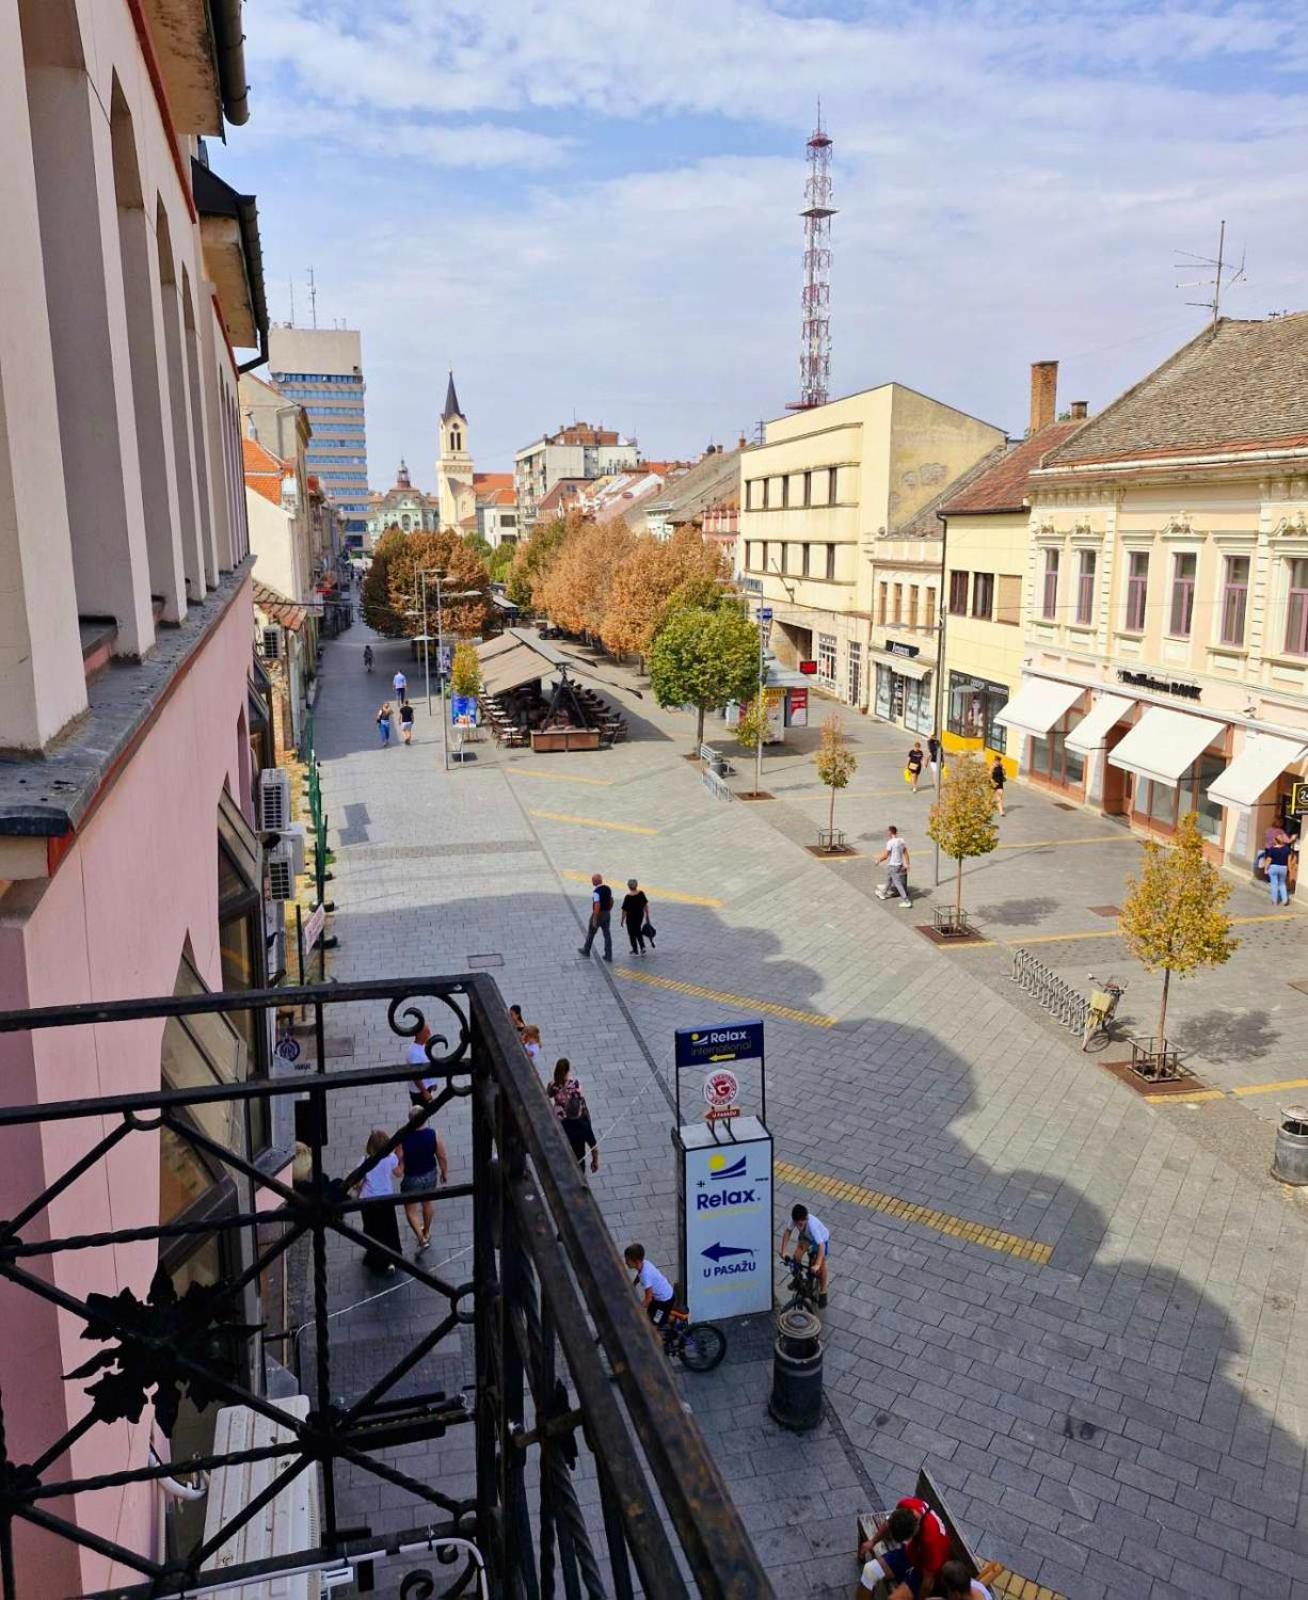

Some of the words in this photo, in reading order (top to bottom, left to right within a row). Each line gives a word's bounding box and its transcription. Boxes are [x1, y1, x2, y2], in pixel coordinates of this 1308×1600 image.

[711, 1031, 747, 1043] Relax
[697, 1189, 755, 1210] Relax
[704, 1268, 711, 1277] U
[714, 1260, 756, 1277] PASAŽU
